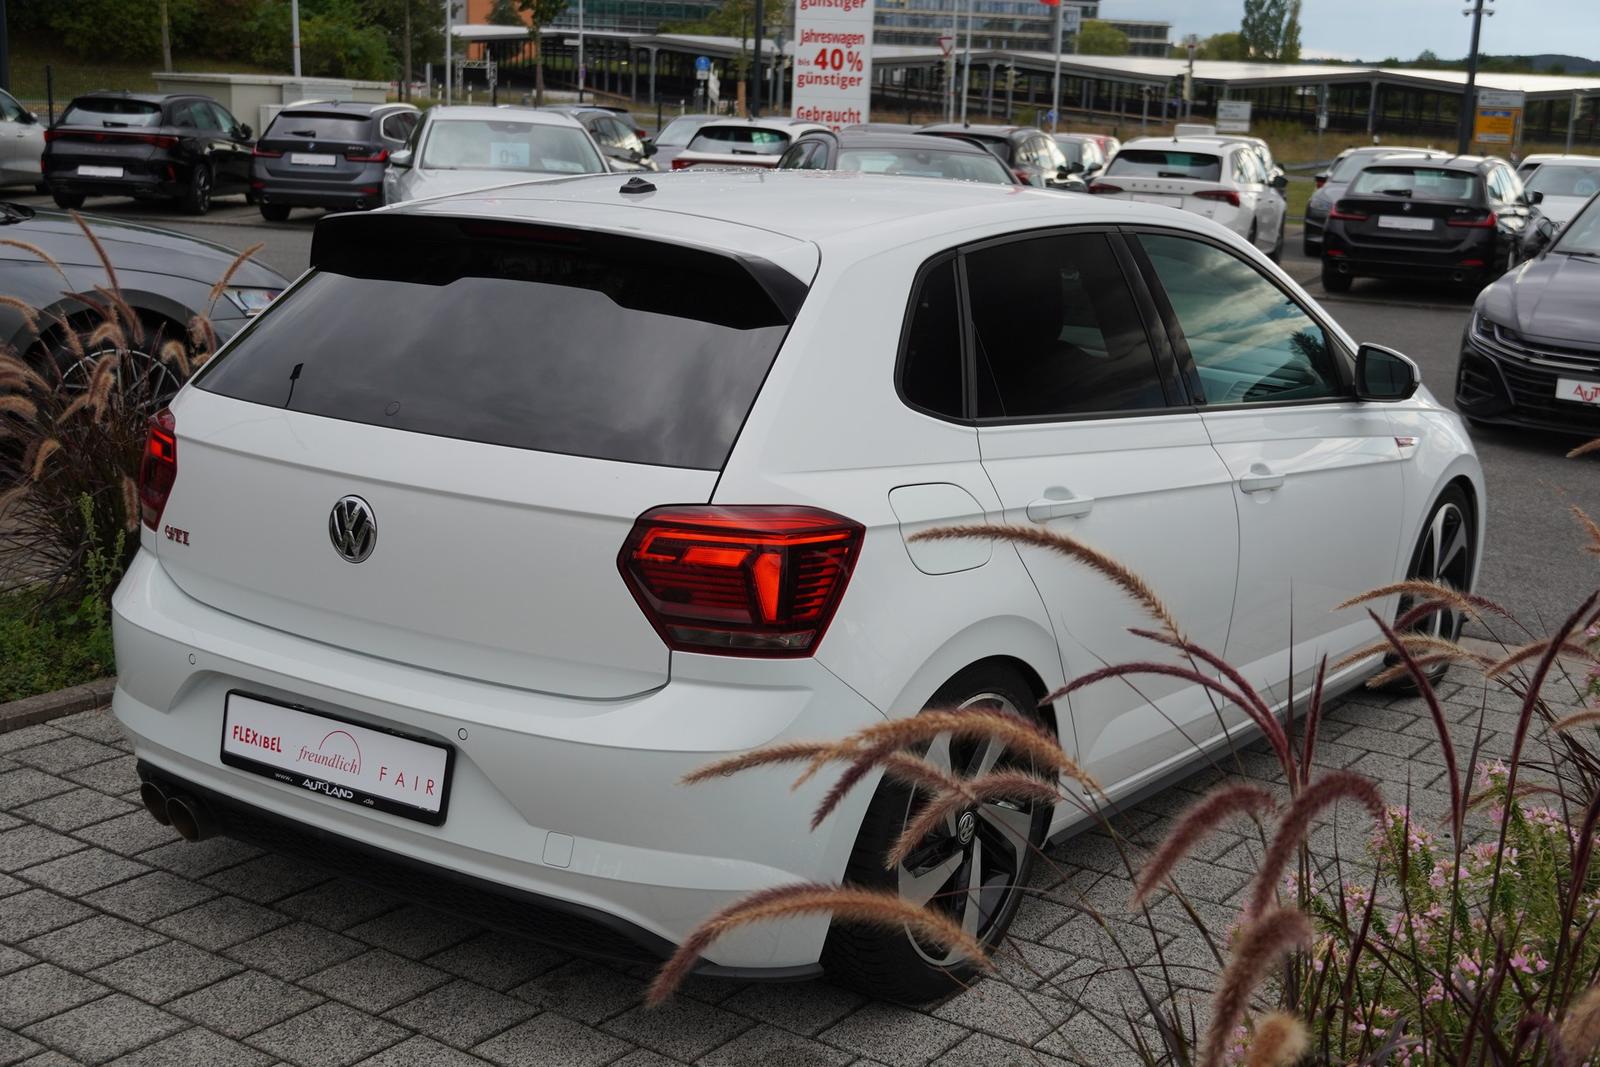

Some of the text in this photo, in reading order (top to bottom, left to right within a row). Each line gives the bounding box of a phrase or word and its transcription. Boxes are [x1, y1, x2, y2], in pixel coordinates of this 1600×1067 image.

[800, 29, 865, 48] Jahreswagen
[797, 72, 864, 90] günstiger
[796, 105, 862, 124] Gebraucht
[164, 524, 191, 547] GTI
[232, 725, 283, 754] FLEXIBEL
[295, 746, 357, 774] freundlich
[274, 772, 375, 806] www. AUTOLAND .de
